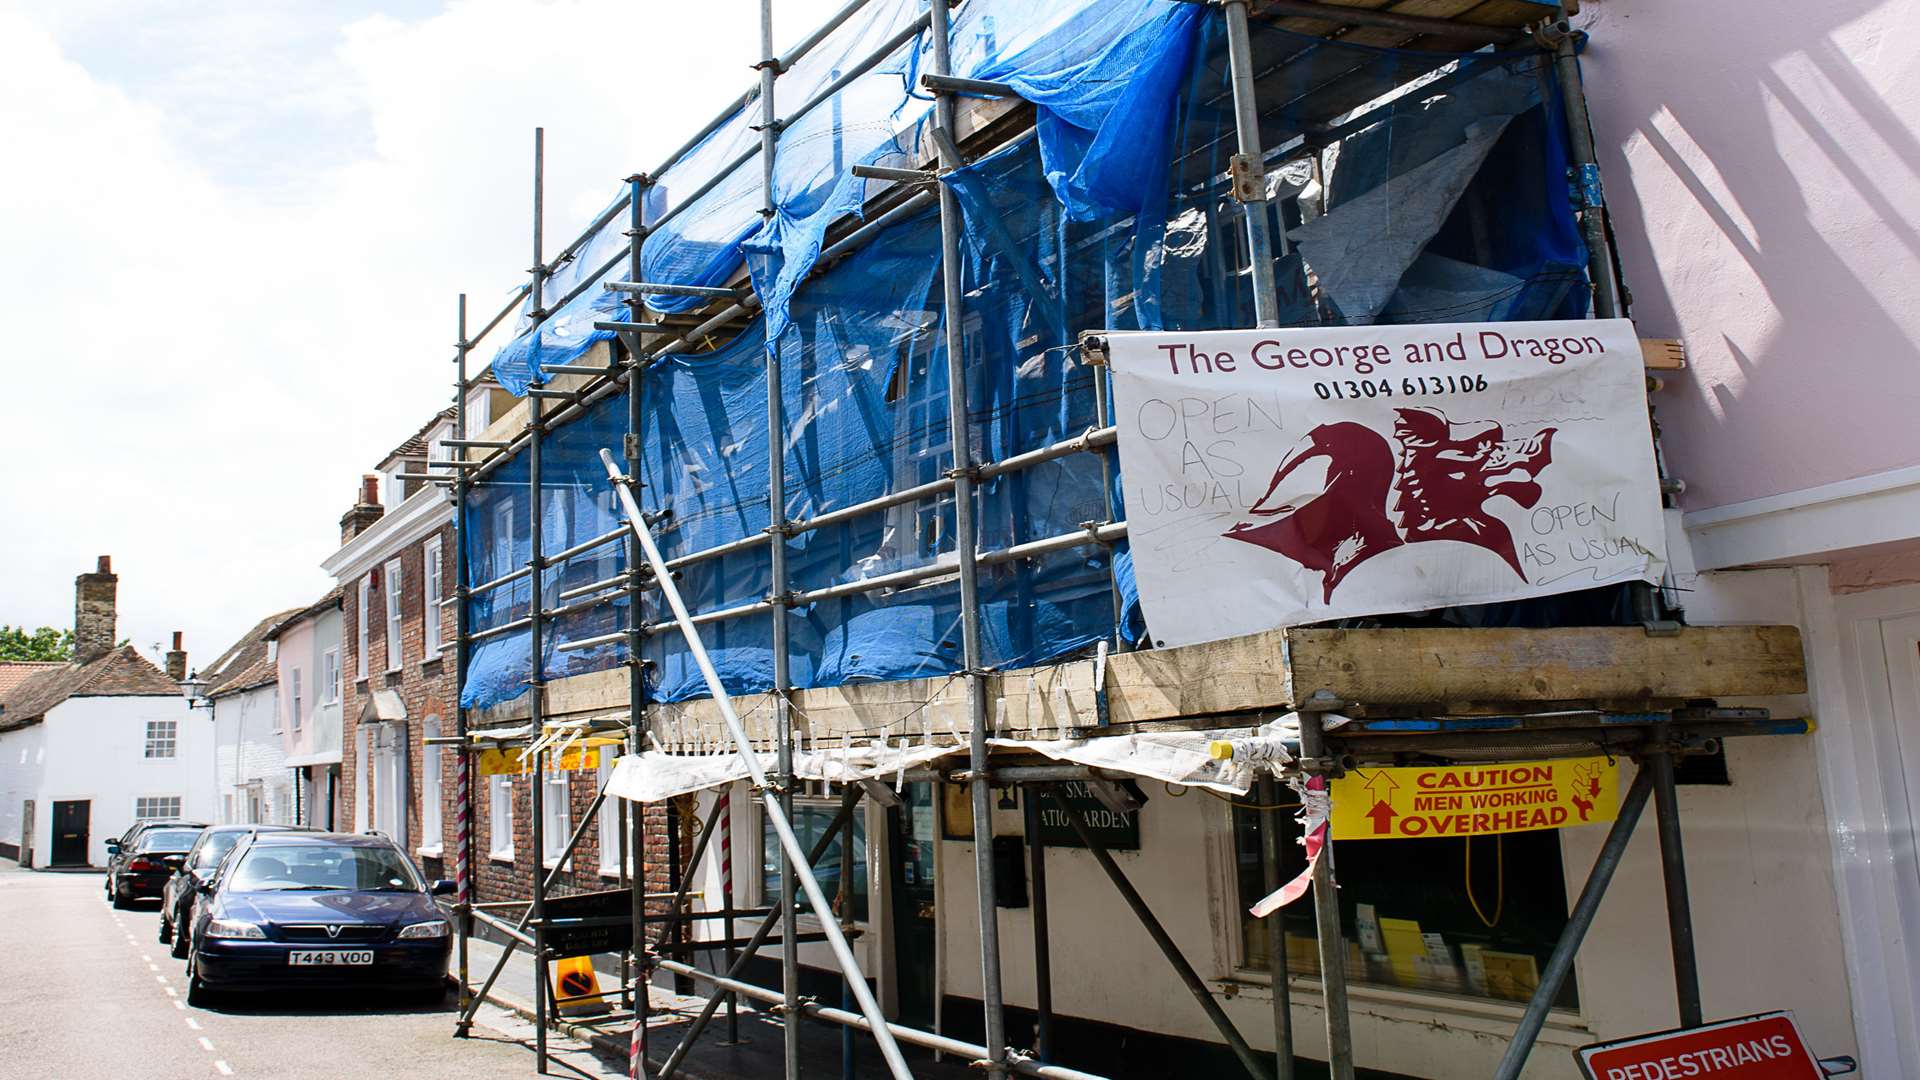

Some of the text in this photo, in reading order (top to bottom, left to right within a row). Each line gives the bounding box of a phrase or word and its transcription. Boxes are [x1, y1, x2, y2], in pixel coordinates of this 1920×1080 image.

[1158, 331, 1605, 375] The George and Dragon
[1313, 379, 1393, 400] 01304
[1402, 374, 1489, 396] 613106
[1138, 390, 1284, 441] OPEN
[1182, 440, 1245, 480] AS
[1140, 479, 1254, 516] USUAL
[1531, 491, 1621, 535] OPEN
[1523, 536, 1655, 567] AS USUAL
[1416, 765, 1553, 789] CAUTION
[1414, 789, 1558, 812] MEN WORKING
[1040, 809, 1131, 829] ATIO ARDEN
[1399, 806, 1568, 836] OVERHEAD
[292, 952, 336, 964] T443
[1606, 1034, 1793, 1080] PEDESTRIANS
